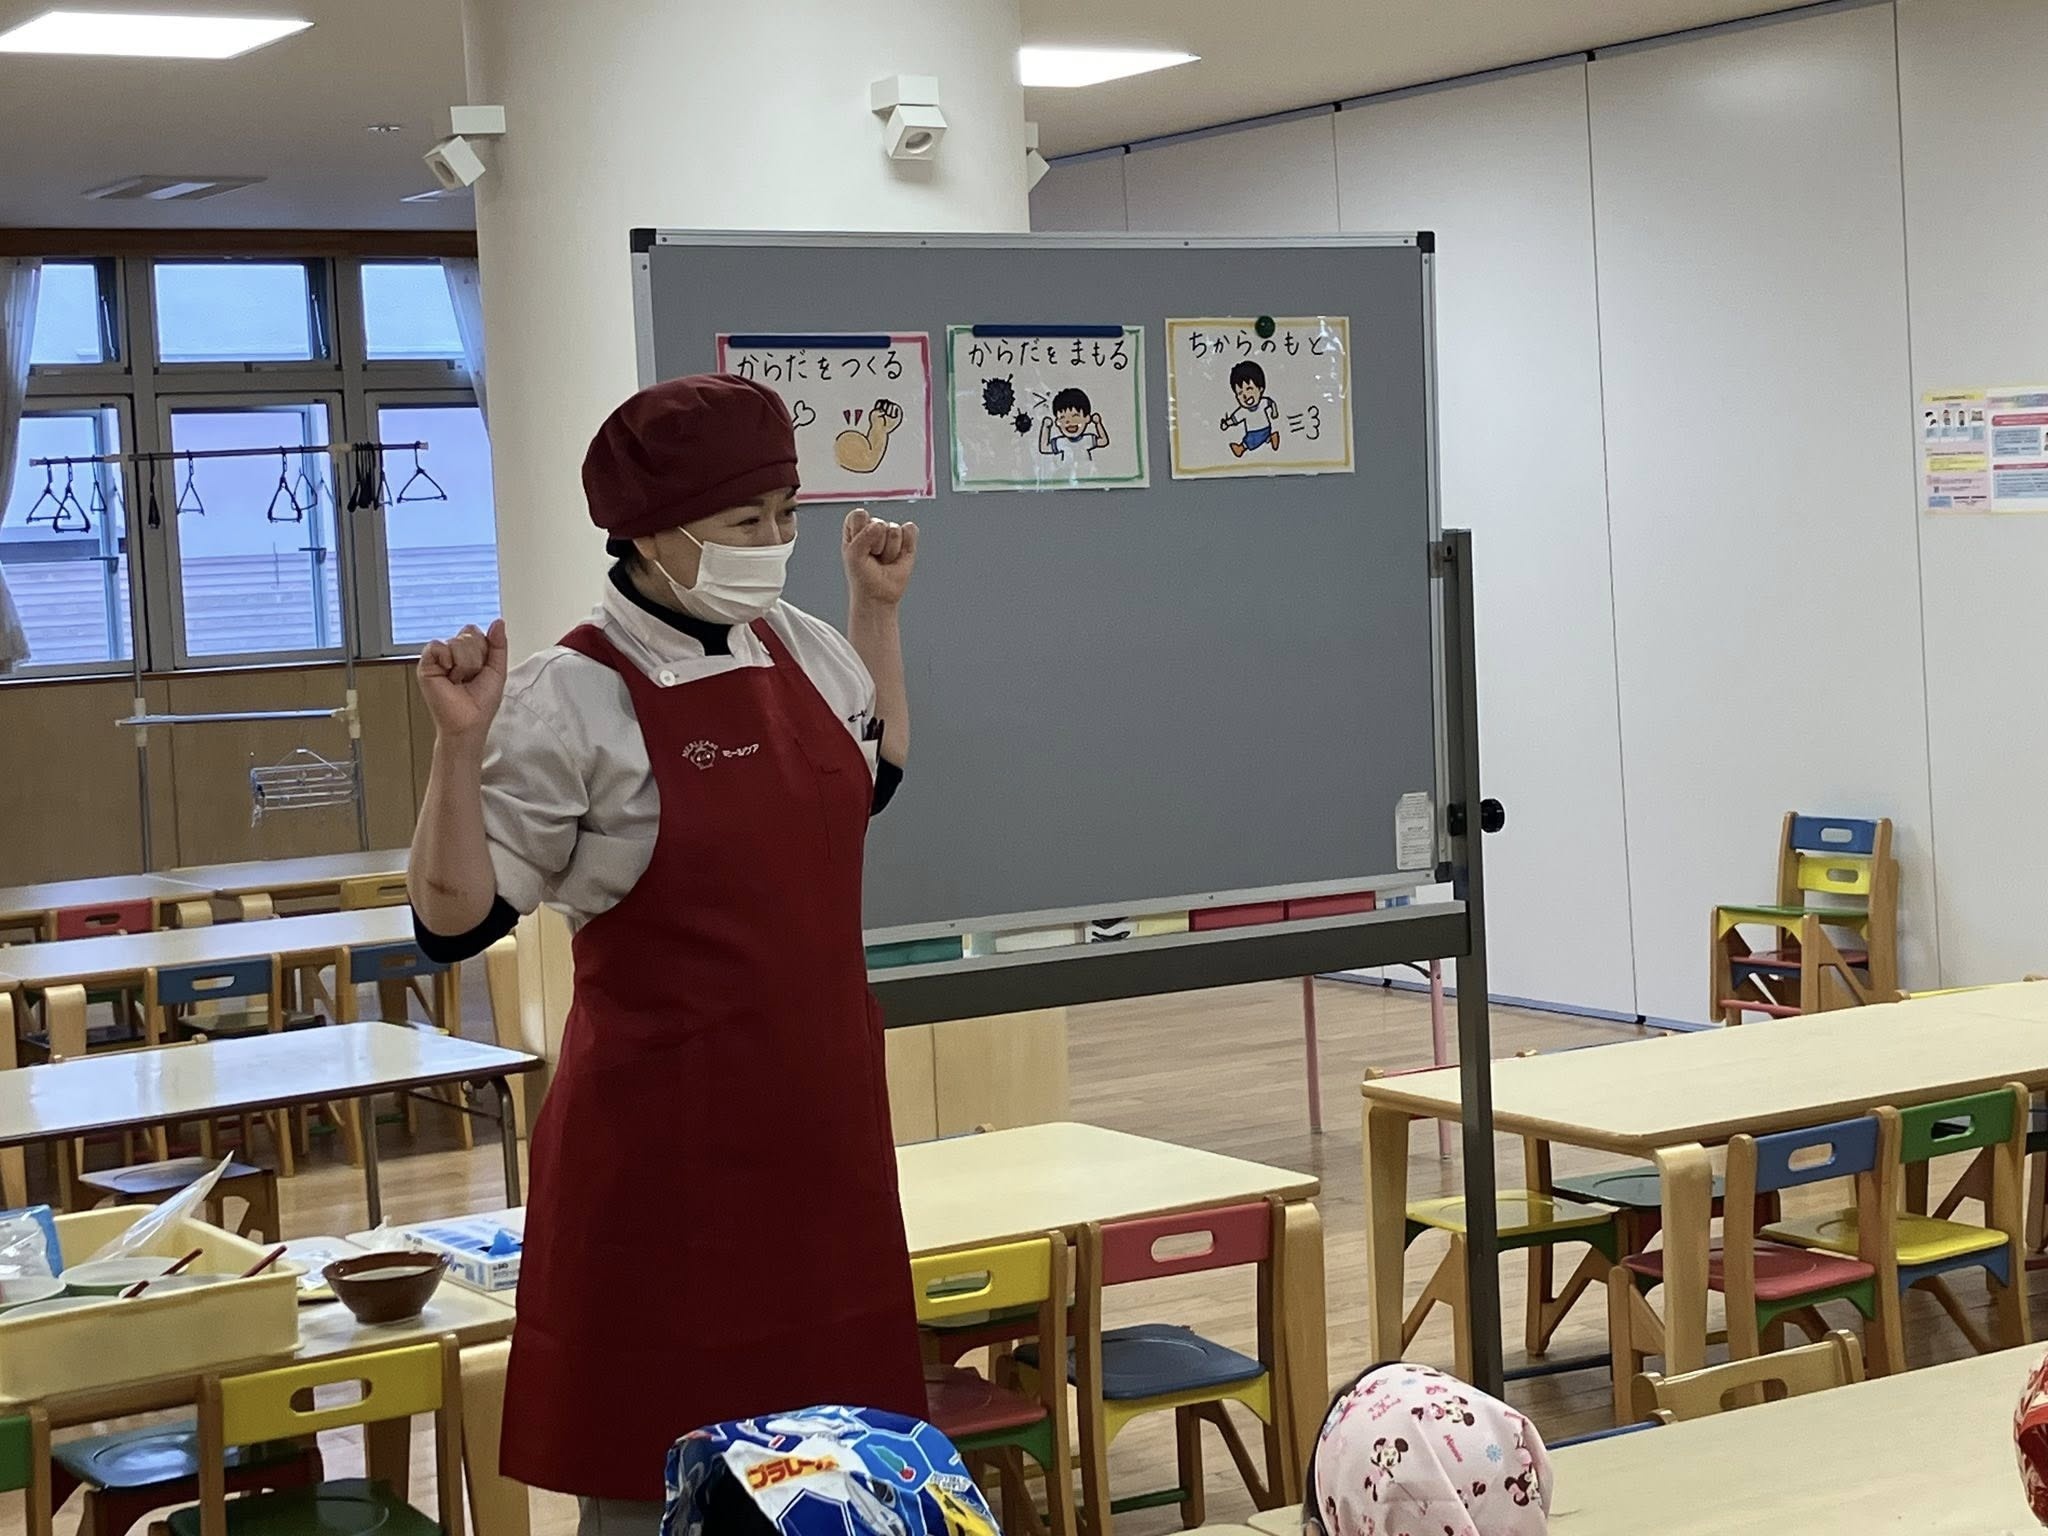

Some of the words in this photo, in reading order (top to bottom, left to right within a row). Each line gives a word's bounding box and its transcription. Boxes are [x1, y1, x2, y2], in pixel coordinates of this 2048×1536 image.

[968, 337, 1129, 370] からだをまもる
[1188, 329, 1324, 358] ちからのもと
[737, 349, 903, 382] からだをつくる
